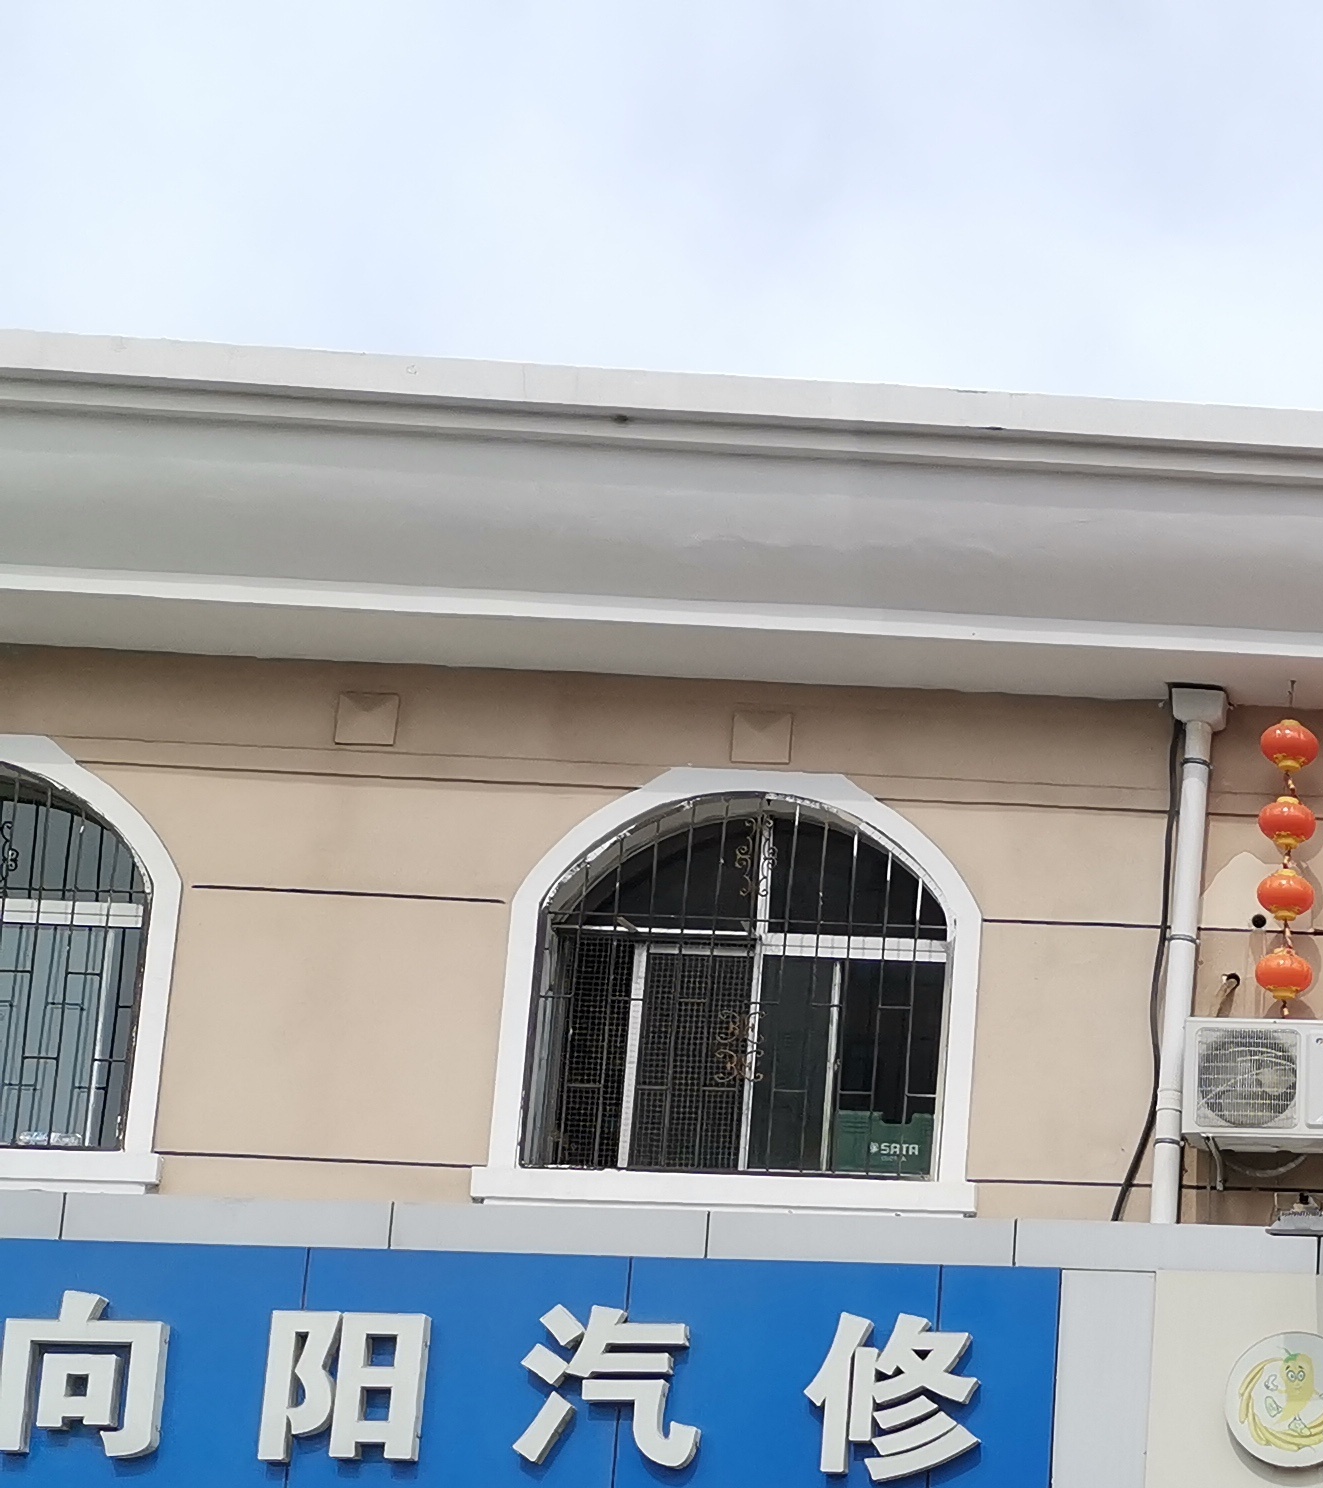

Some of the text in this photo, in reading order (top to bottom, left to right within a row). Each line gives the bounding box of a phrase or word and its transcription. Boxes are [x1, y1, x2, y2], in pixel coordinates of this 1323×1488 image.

[880, 1142, 919, 1155] SATA
[0, 1289, 981, 1483] 向阳汽修
